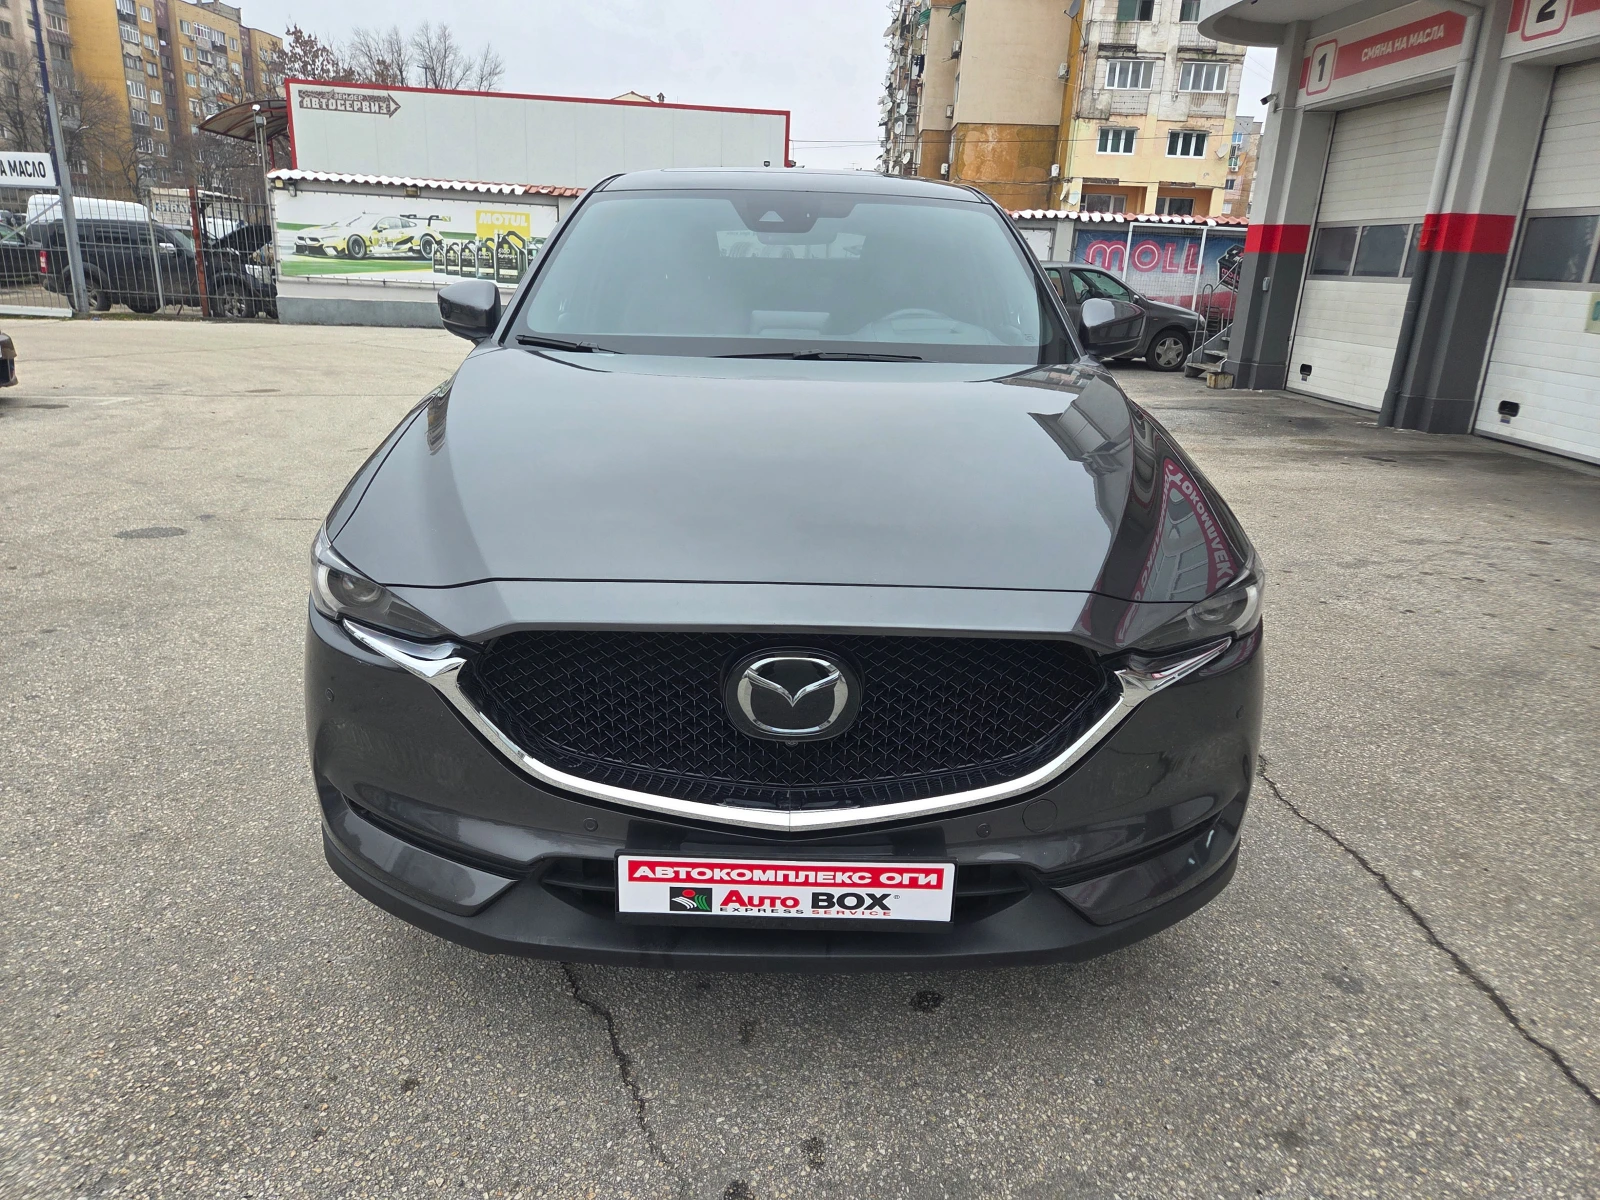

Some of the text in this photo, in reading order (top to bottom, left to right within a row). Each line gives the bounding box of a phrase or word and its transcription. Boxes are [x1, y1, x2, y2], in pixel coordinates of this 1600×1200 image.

[1361, 24, 1445, 62] СМЯНА НА МАСЛА
[1318, 53, 1328, 82] 1
[303, 97, 388, 114] АВТОСЕРВИЗ
[7, 159, 46, 178] МАСЛО
[478, 212, 528, 226] MOTUL
[633, 865, 938, 886] АВТОКОМПЛЕКС ОГИ
[811, 892, 891, 911] BOX
[811, 909, 891, 917] SERVICE
